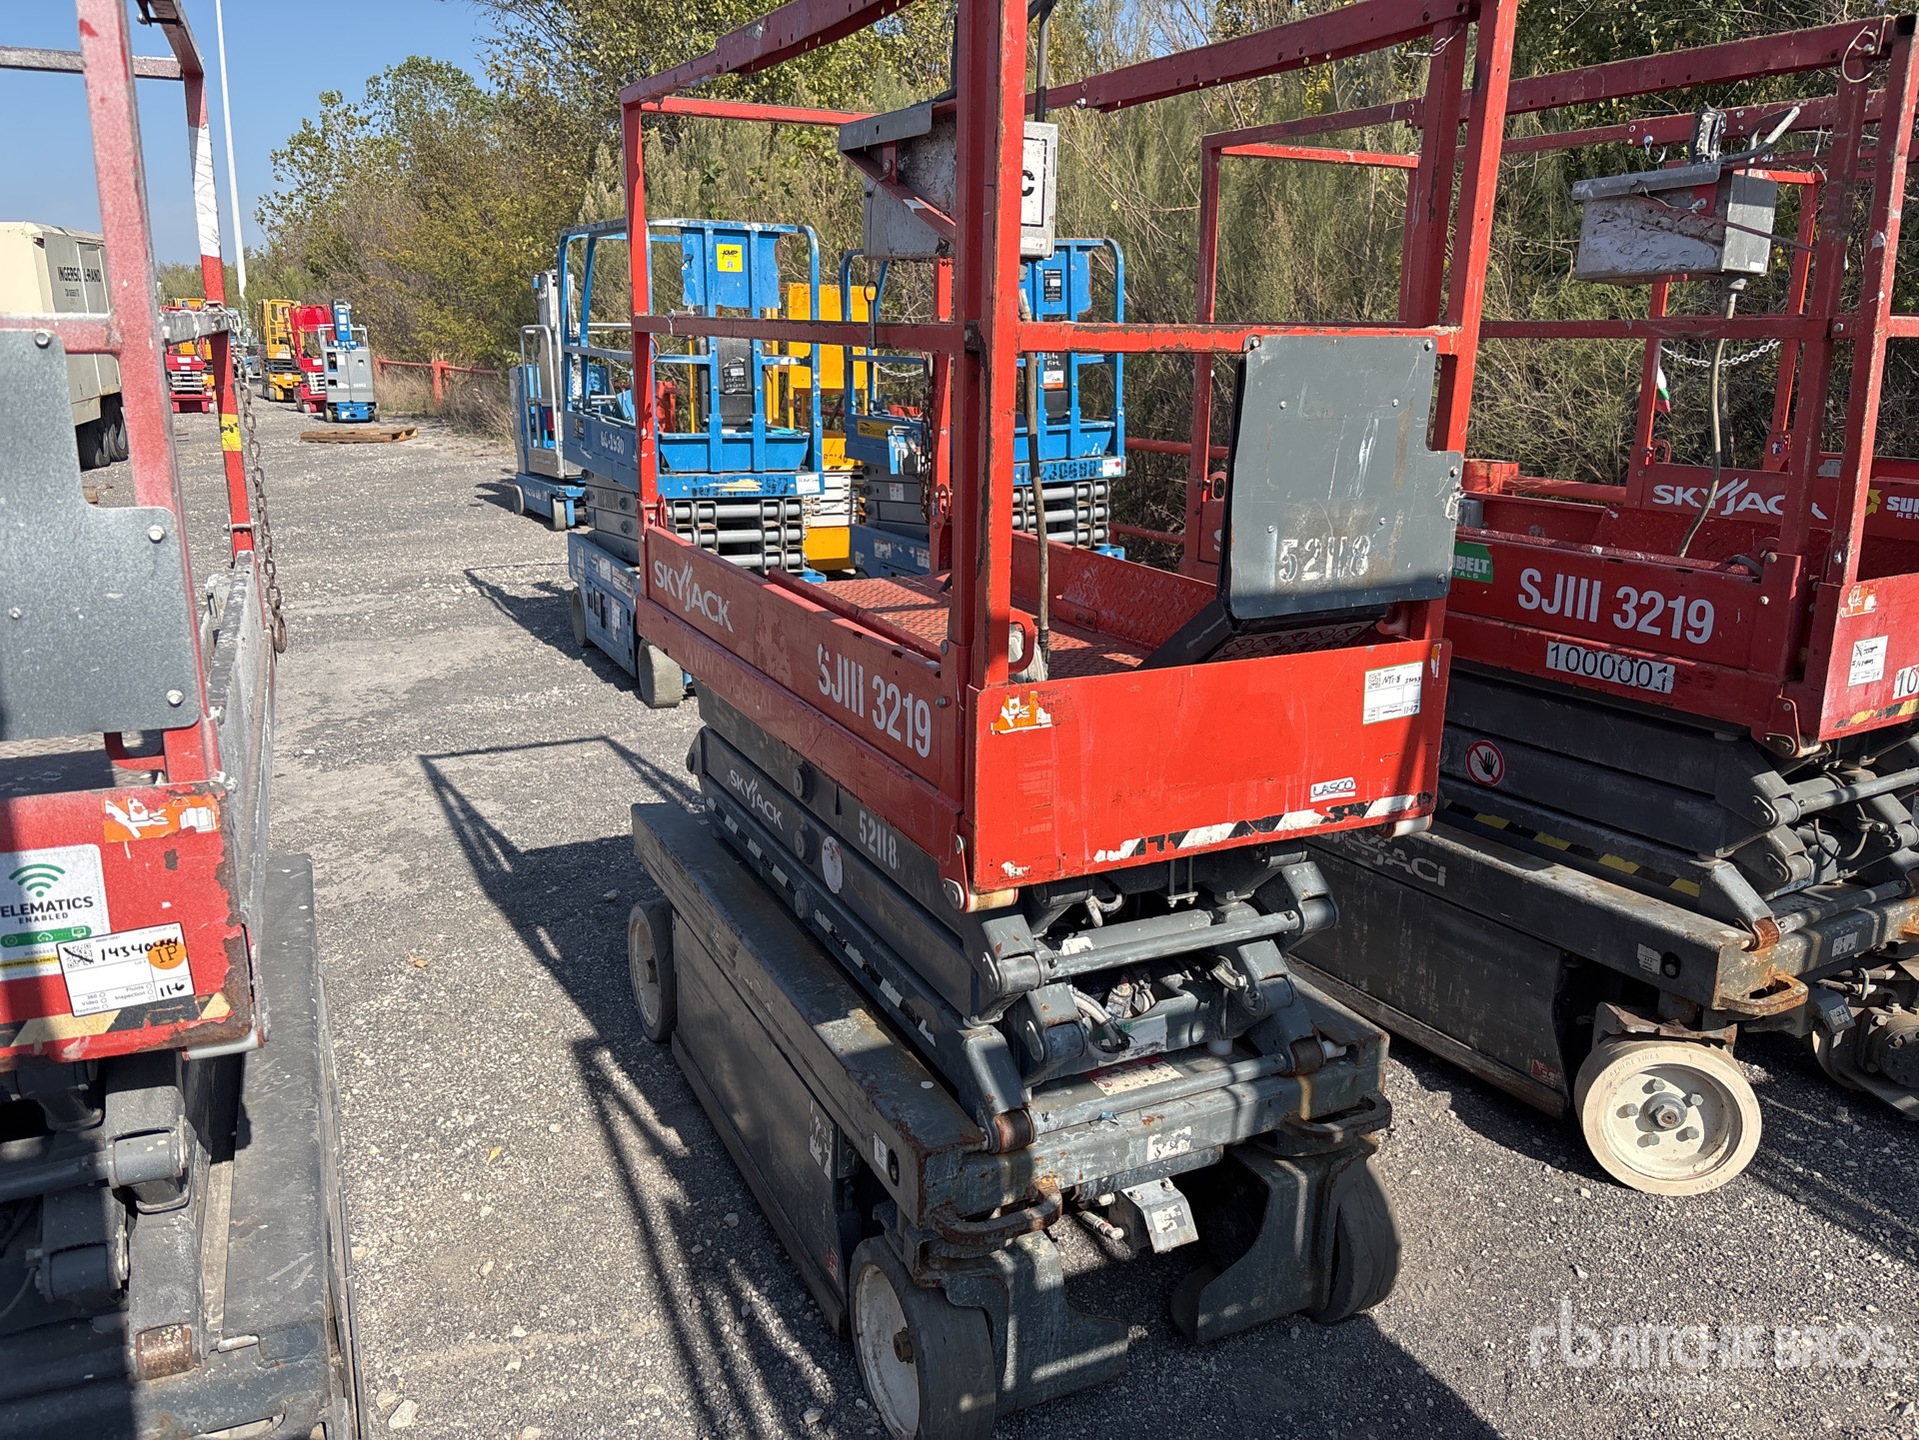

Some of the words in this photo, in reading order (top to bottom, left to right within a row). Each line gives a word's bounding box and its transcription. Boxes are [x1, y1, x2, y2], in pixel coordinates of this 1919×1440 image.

[1278, 535, 1370, 583] 52118
[654, 557, 734, 632] SKYJACK
[1517, 568, 1602, 624] SJIII
[1612, 586, 1715, 645] 3219
[1550, 646, 1670, 692] 1000001
[817, 642, 864, 719] SJIII
[872, 674, 932, 758] 3219
[730, 769, 783, 830] SKYJACK
[1313, 779, 1354, 796] LASCO
[858, 810, 897, 870] 52118
[0, 895, 94, 919] ELEMATICS
[19, 911, 69, 925] ENABLED
[115, 990, 146, 1000] Inspection
[160, 983, 185, 998] 11-6
